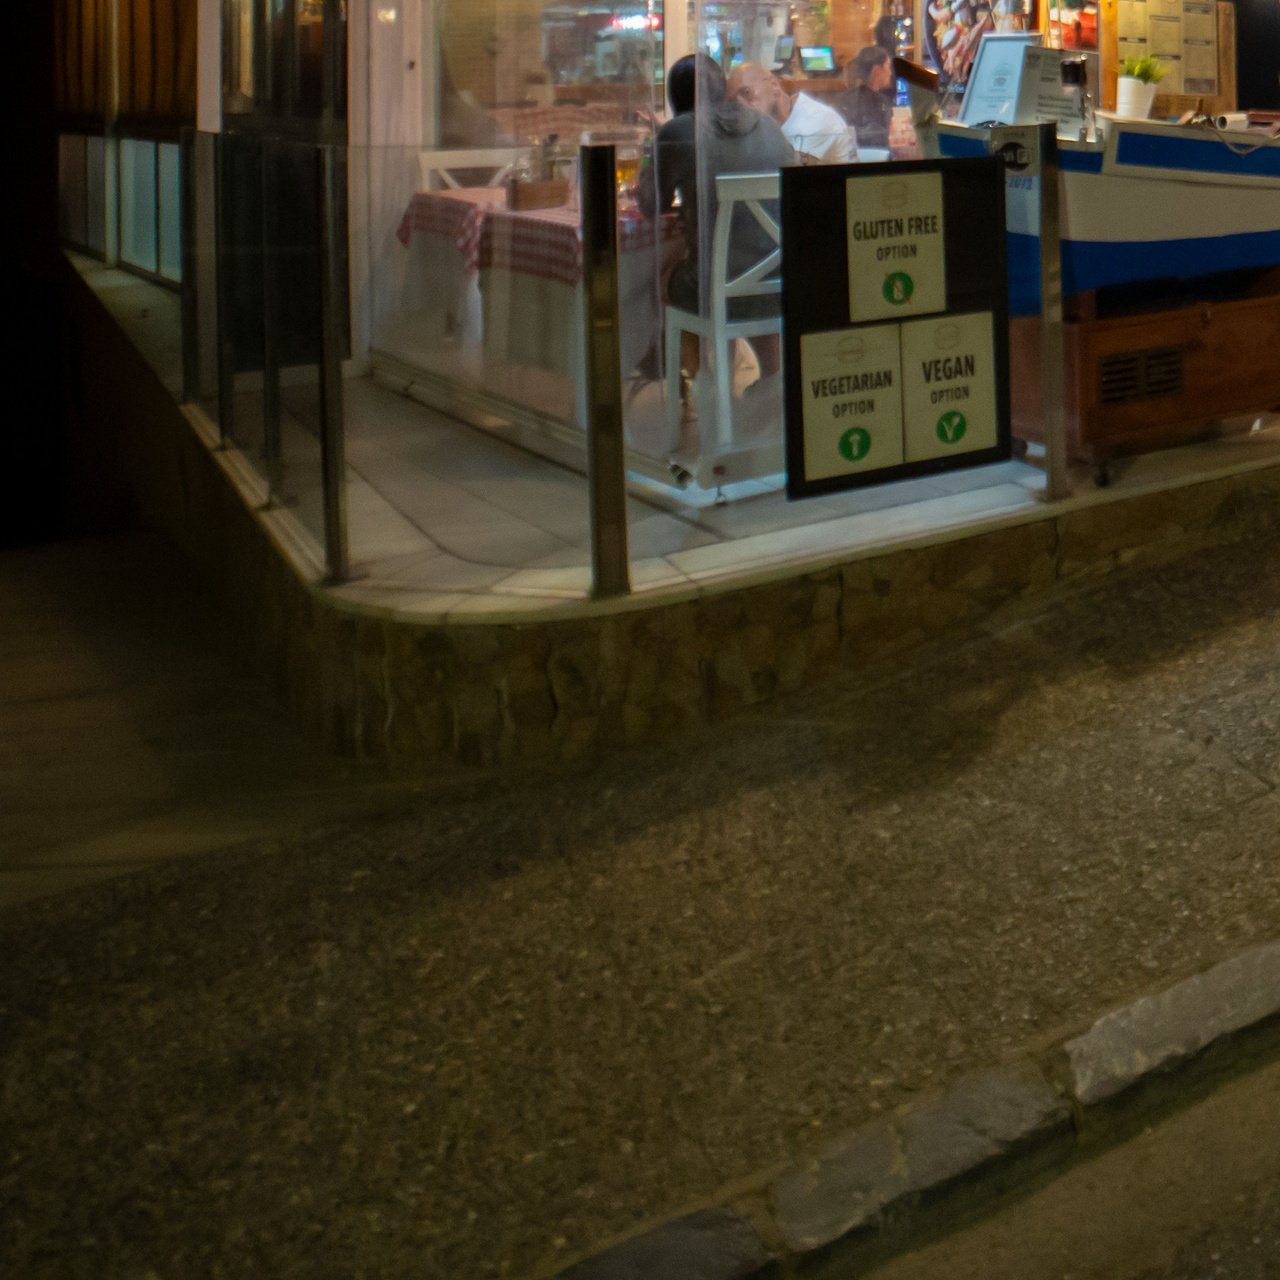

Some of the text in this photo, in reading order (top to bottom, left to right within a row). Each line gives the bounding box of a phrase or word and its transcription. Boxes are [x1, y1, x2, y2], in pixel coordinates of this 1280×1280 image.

[852, 215, 939, 242] GLUTEN FREE
[876, 243, 918, 262] OPTION
[922, 354, 976, 384] VEGAN
[811, 370, 893, 400] VEGETARIAN
[930, 385, 970, 404] OPTION
[832, 399, 875, 418] OPTION
